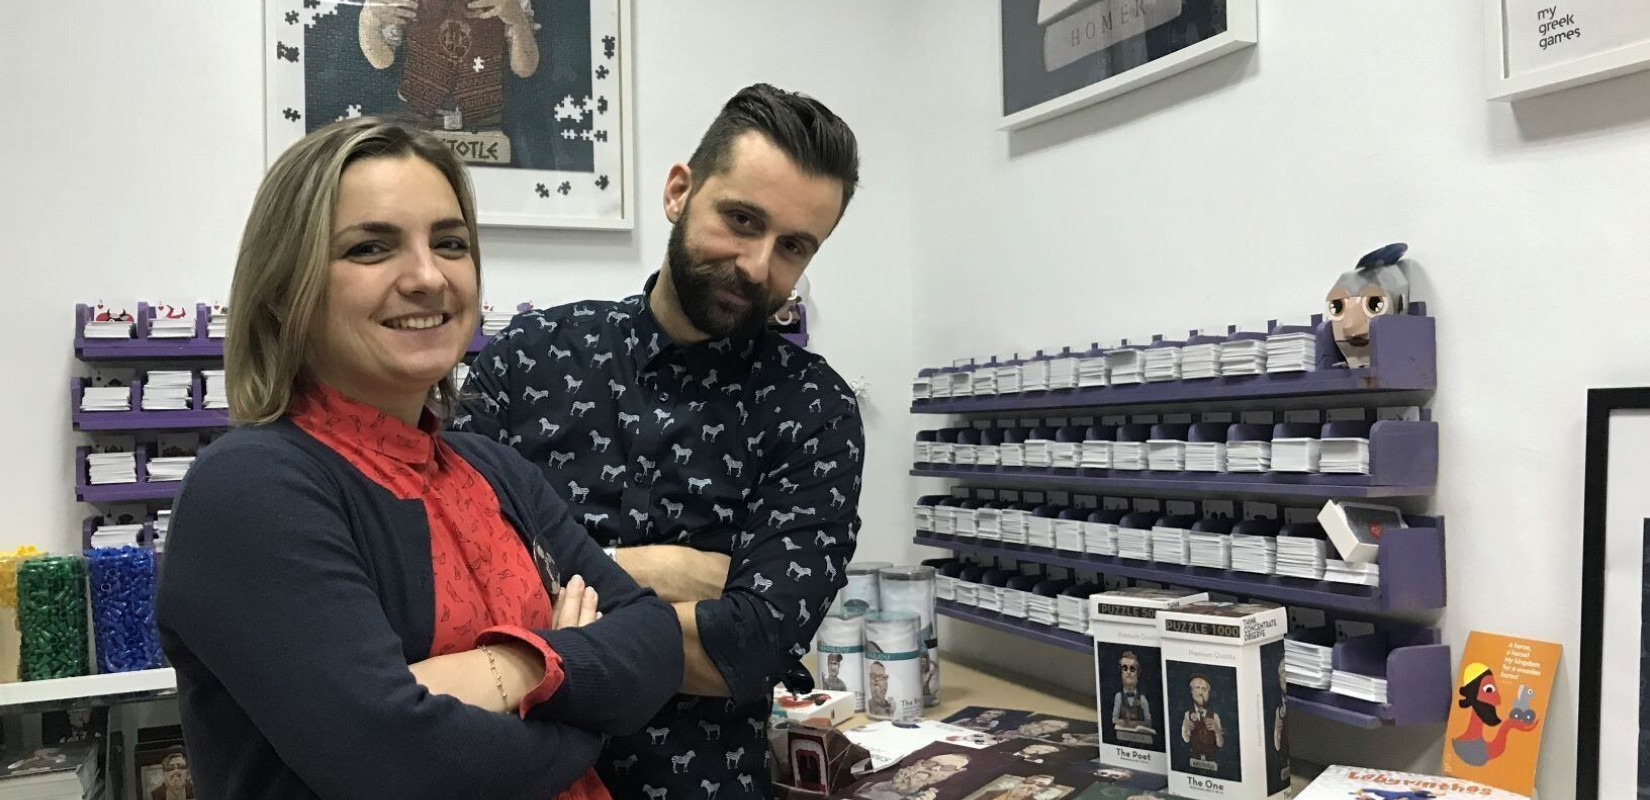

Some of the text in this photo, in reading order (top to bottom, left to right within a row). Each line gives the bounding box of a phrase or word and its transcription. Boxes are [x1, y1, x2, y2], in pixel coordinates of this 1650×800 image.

[1537, 5, 1557, 21] my
[1070, 0, 1146, 47] HOMER
[1538, 13, 1575, 36] greek
[1538, 27, 1581, 51] games
[443, 138, 499, 160] TOTLE
[1101, 603, 1155, 619] PUZZLE 50
[1165, 620, 1240, 638] PUZZLE 1000
[1242, 617, 1257, 626] THINK
[1243, 619, 1277, 634] CONCENTRATE
[1244, 630, 1266, 642] OBSERVE
[1116, 747, 1130, 757] The
[1132, 750, 1152, 761] Poet
[1186, 776, 1203, 787] The
[1205, 779, 1224, 791] One
